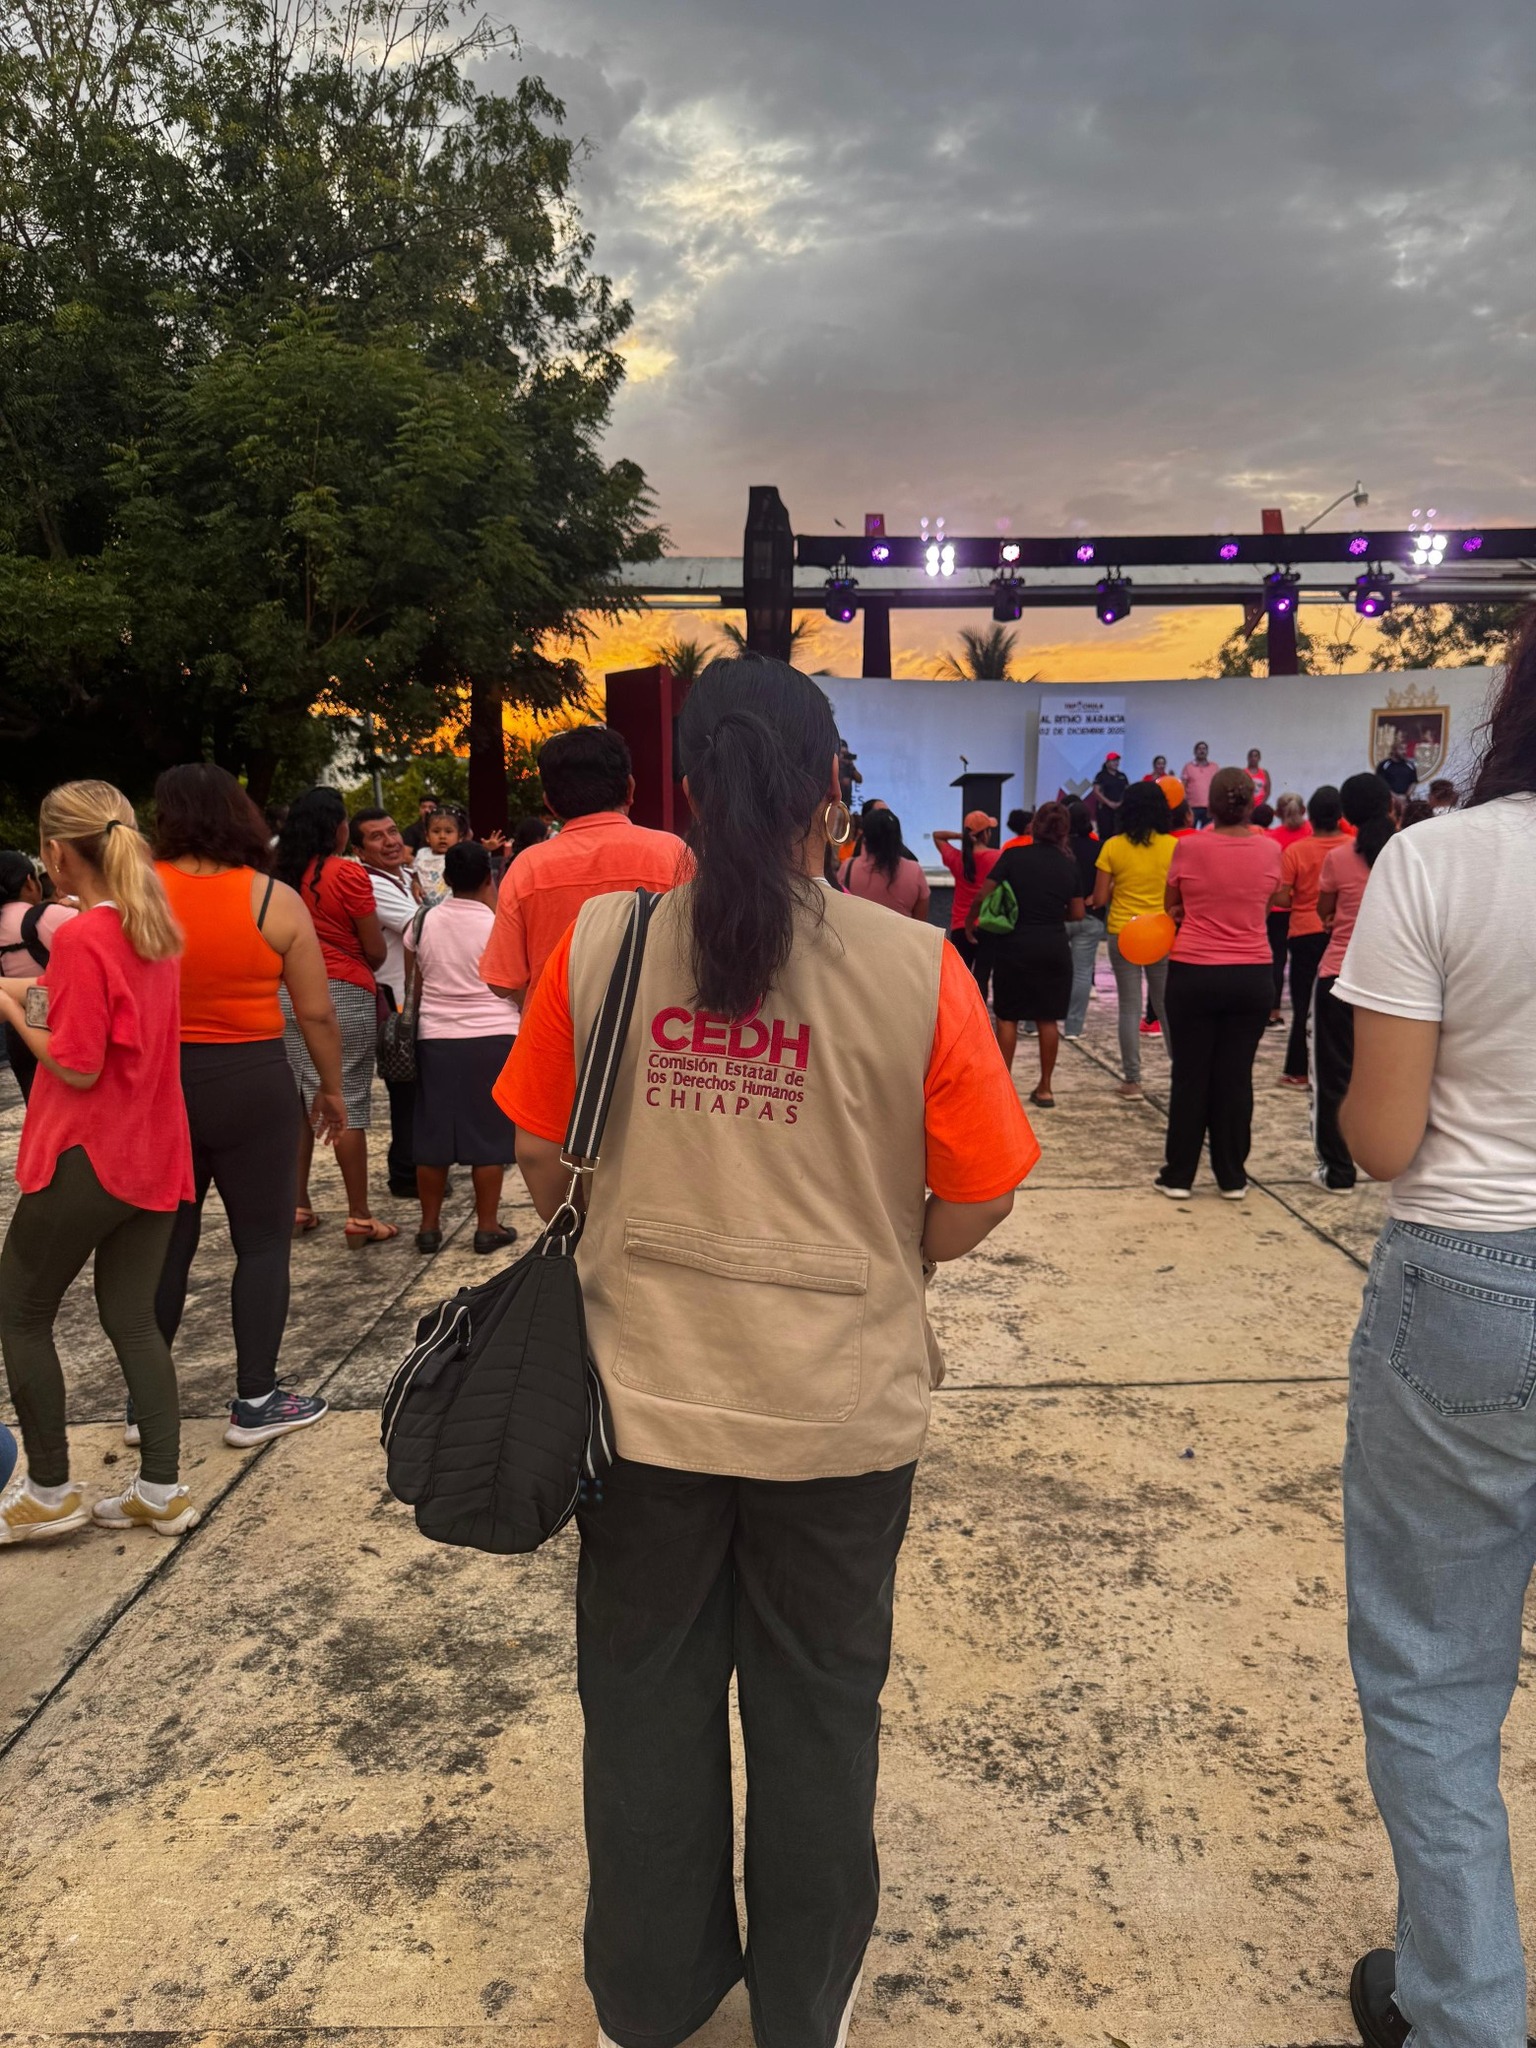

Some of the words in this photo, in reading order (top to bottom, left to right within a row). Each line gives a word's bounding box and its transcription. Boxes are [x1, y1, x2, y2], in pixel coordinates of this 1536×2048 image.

[1040, 715, 1051, 724] AL
[1054, 715, 1082, 724] RITMO
[1085, 715, 1125, 723] NARANJA
[1053, 727, 1064, 735] DE
[1067, 727, 1105, 735] DICIEMBRE
[651, 1006, 810, 1068] CEDH
[647, 1068, 667, 1084] los
[673, 1072, 736, 1091] Derechos
[742, 1081, 804, 1103] Humanos
[648, 1054, 718, 1073] Comisión
[725, 1061, 778, 1082] Estatal
[784, 1071, 804, 1087] de
[646, 1087, 798, 1125] CHIAPAS
